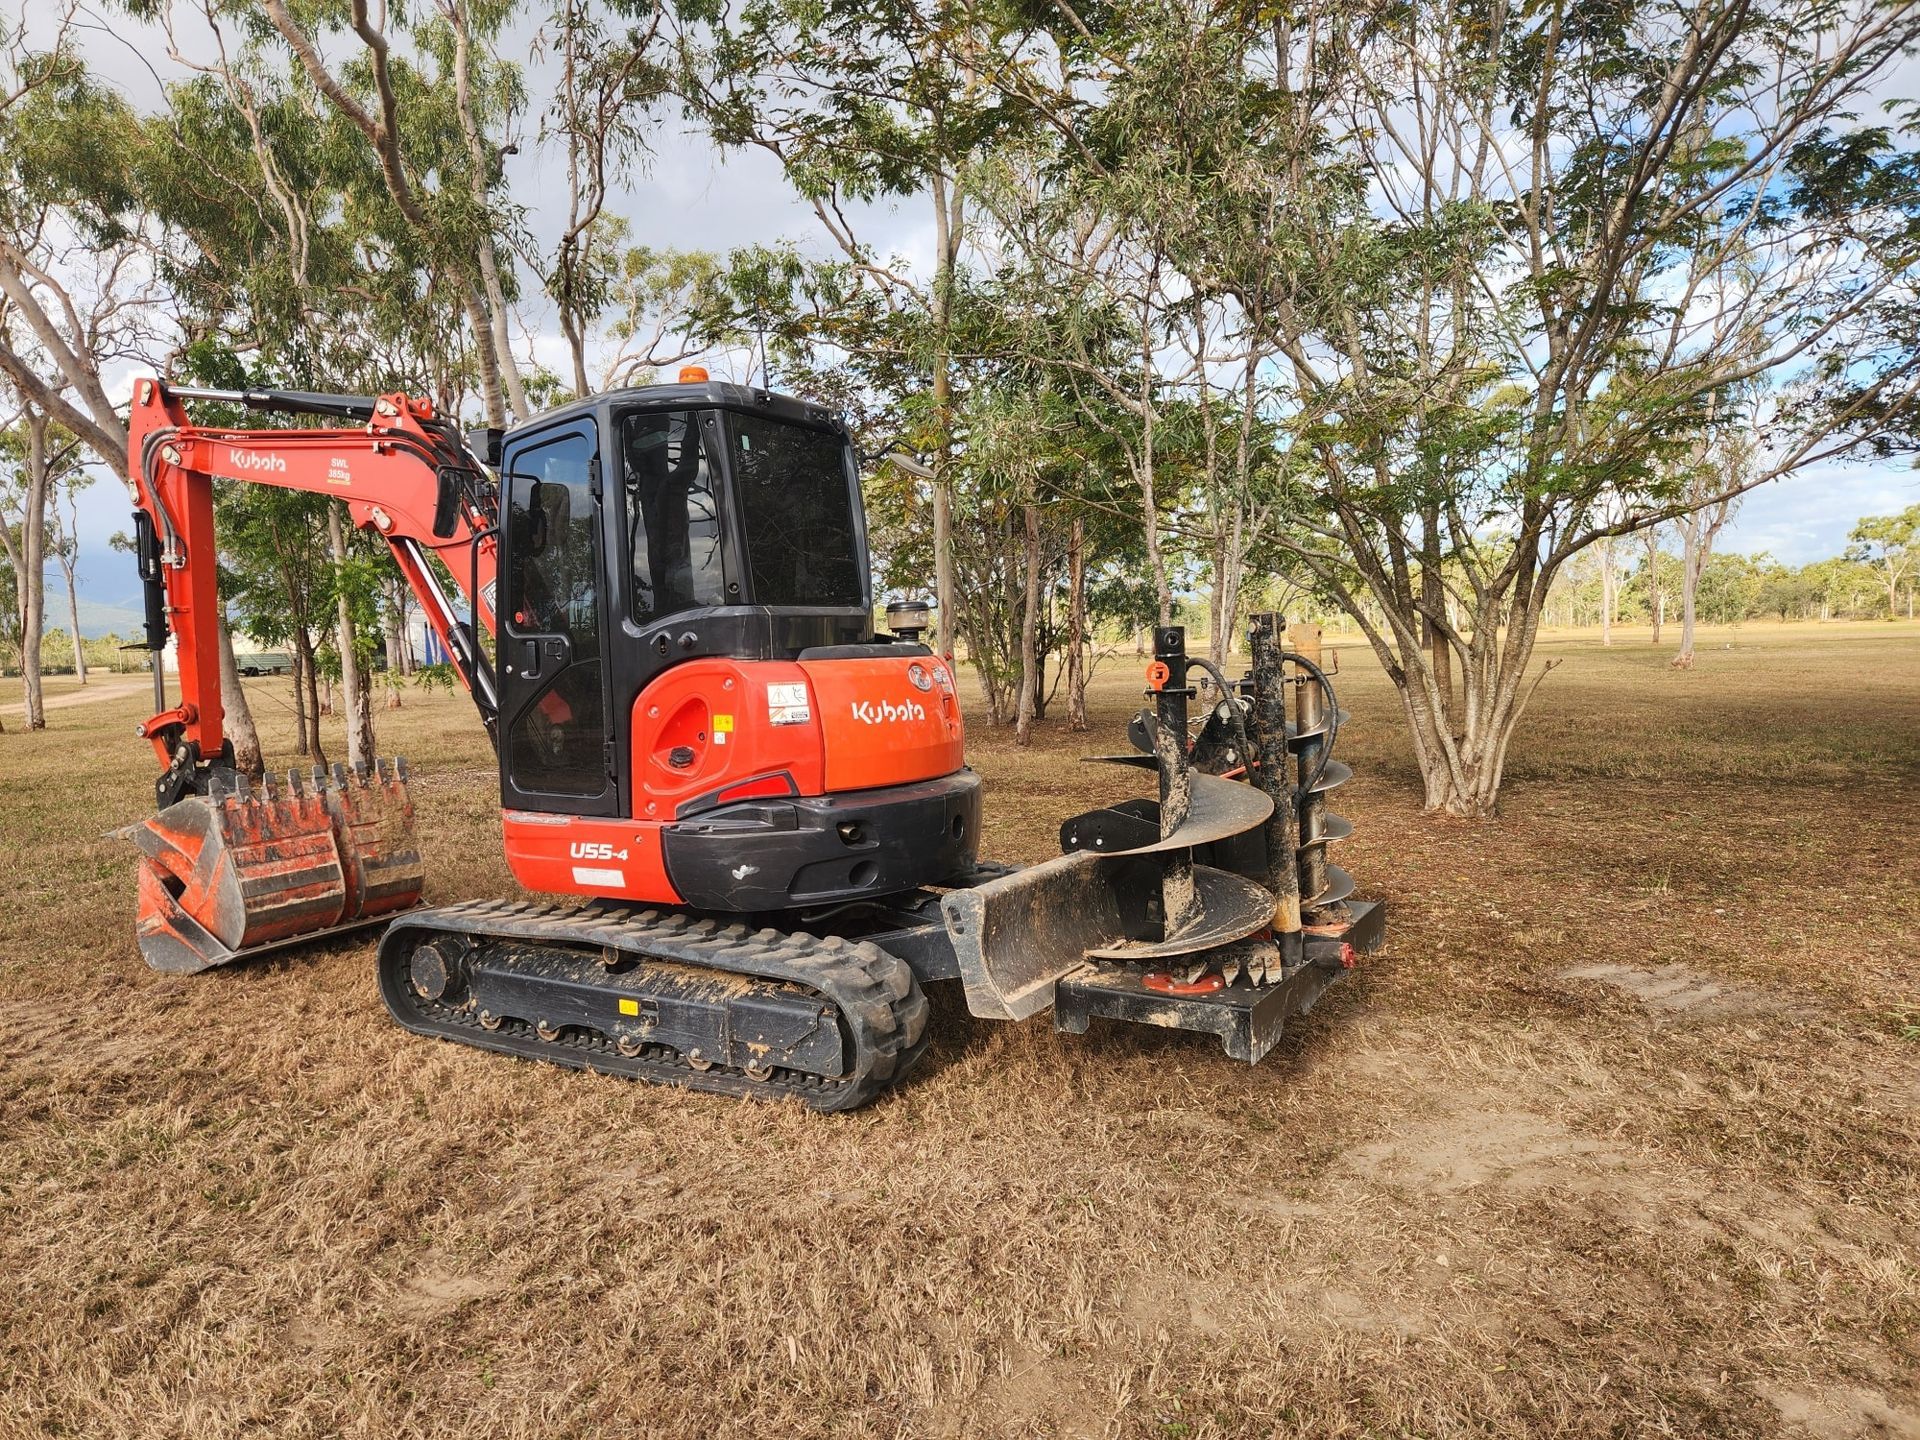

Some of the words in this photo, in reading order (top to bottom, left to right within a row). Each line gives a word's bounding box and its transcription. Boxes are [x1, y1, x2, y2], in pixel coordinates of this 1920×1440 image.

[230, 449, 286, 472] Kubota
[330, 457, 349, 469] SWL
[851, 698, 925, 725] Kubota
[570, 842, 629, 861] U55-4
